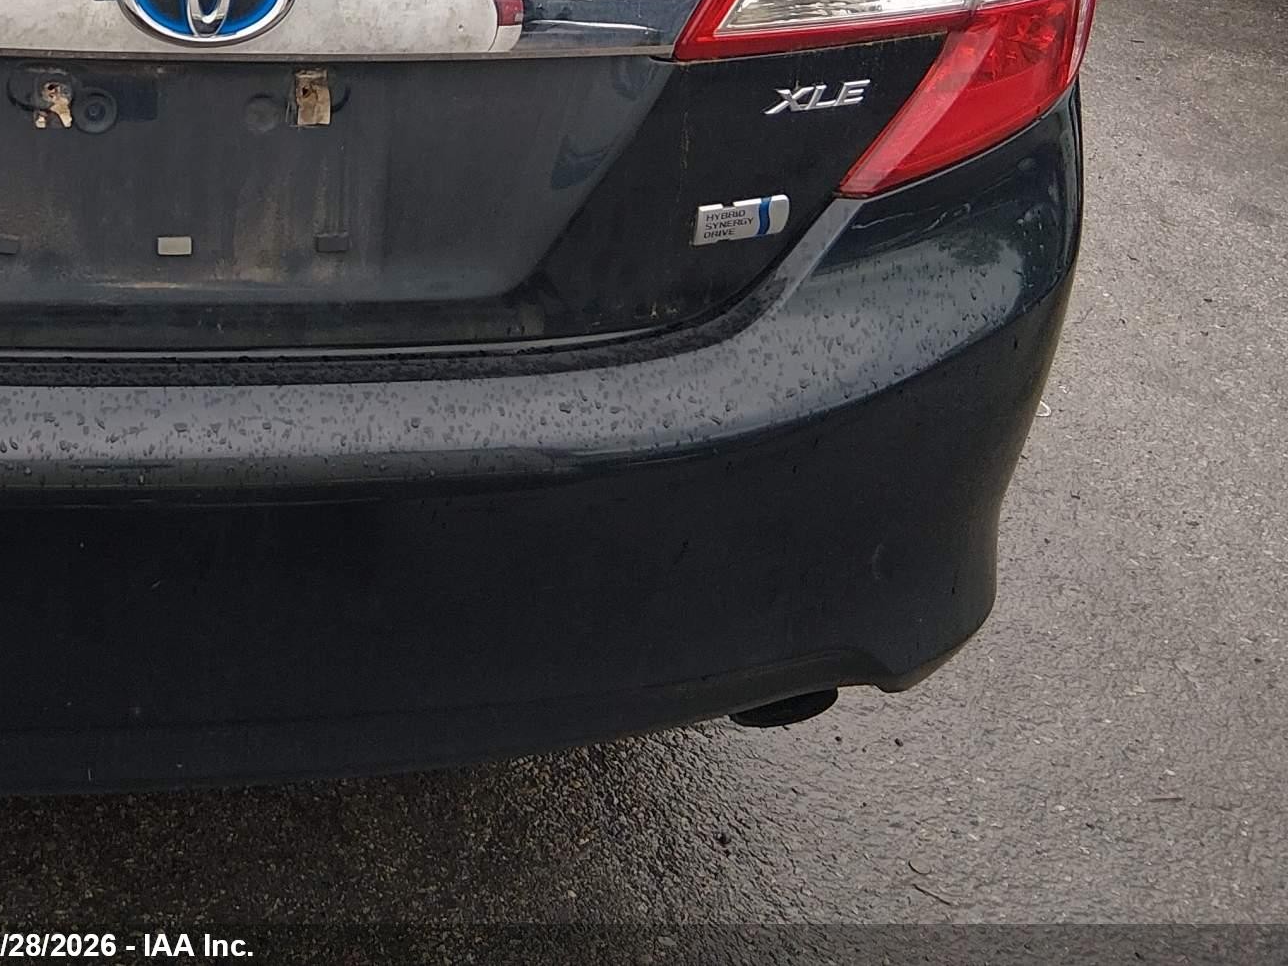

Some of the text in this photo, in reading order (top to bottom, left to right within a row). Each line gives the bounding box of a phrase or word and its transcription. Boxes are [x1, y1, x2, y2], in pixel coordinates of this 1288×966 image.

[761, 79, 871, 115] XLE
[706, 209, 746, 222] HYBRID
[705, 218, 753, 231] SYNERGY
[703, 229, 736, 239] DRIVE
